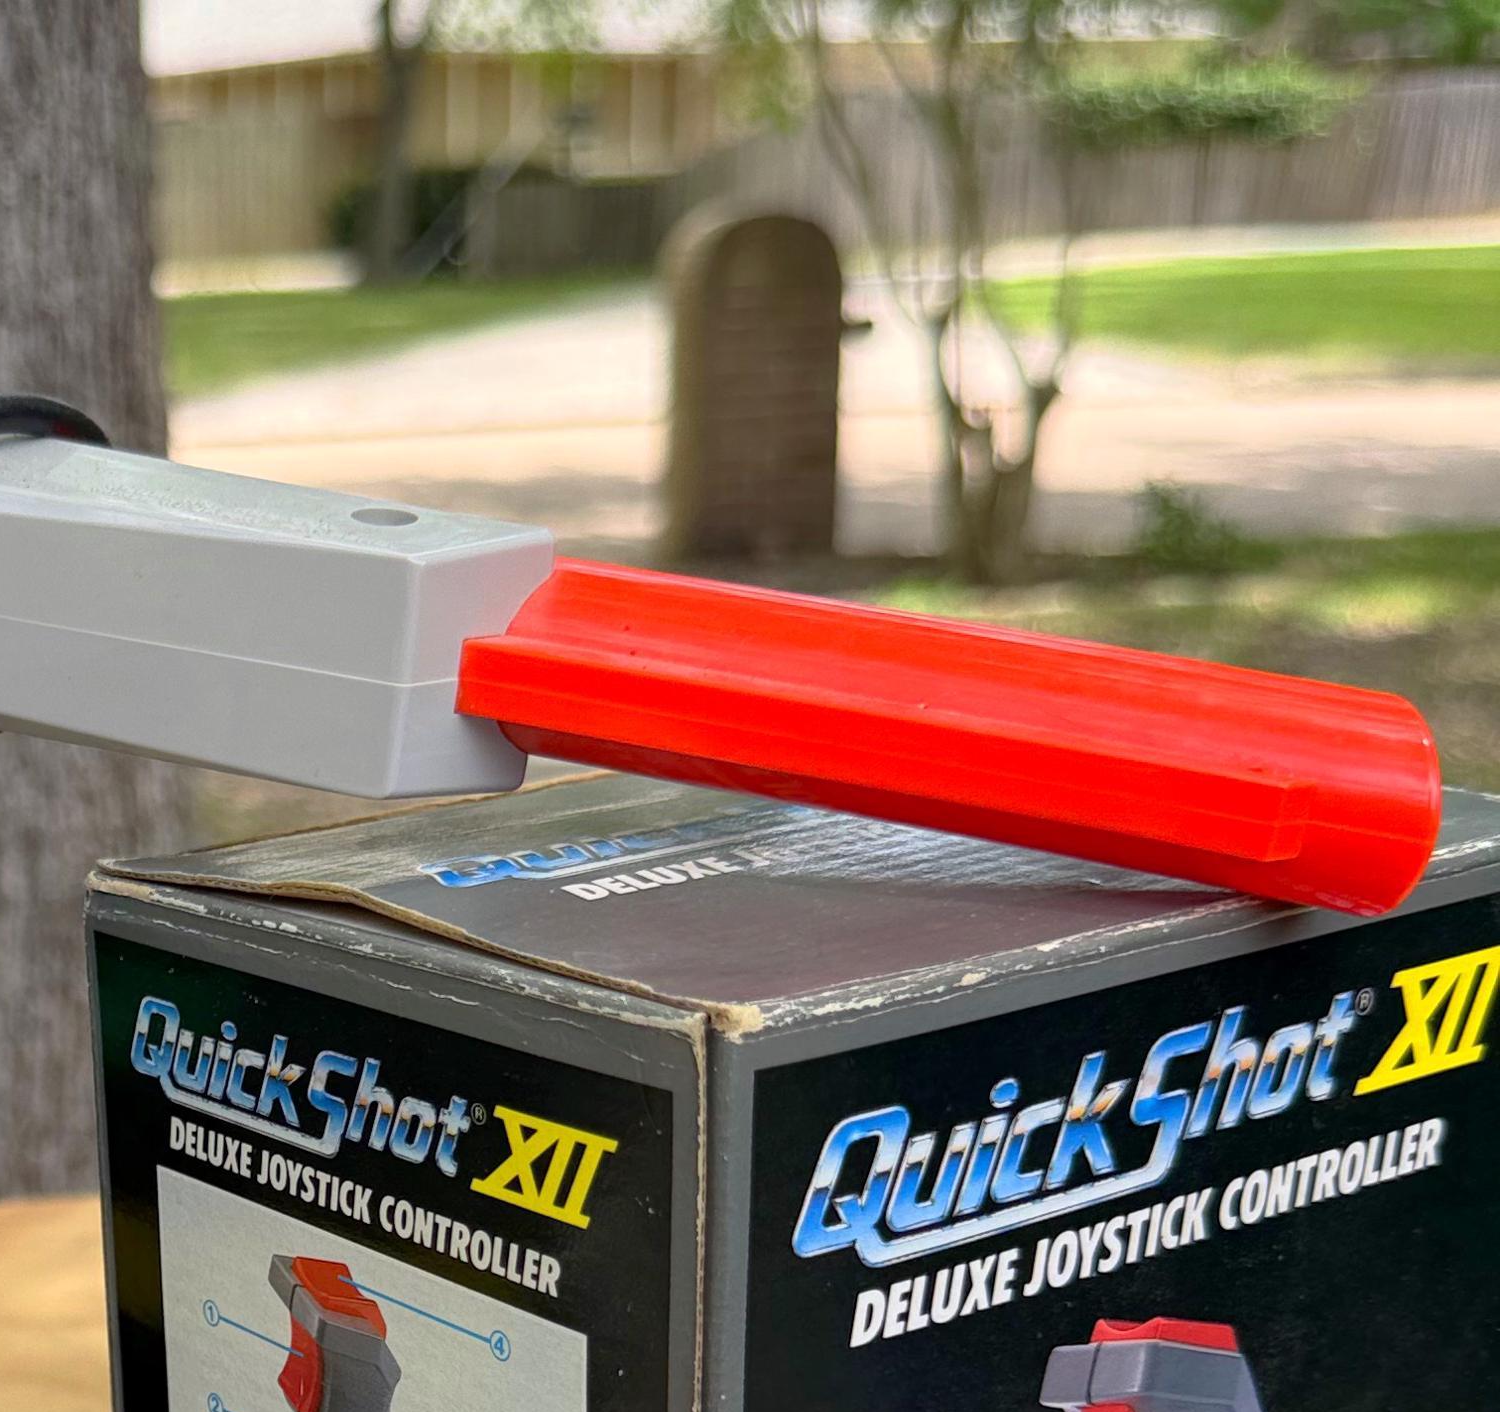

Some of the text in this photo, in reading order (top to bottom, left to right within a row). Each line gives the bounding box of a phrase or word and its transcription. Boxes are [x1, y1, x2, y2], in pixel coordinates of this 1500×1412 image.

[559, 855, 744, 901] DELUXE
[1352, 945, 1500, 1097] XII
[169, 1115, 562, 1299] DELUXE JOYSTICK CONTROLLER
[471, 1105, 618, 1230] XII
[849, 1117, 1447, 1349] DELUXE JOYSTICK CONTROLLER
